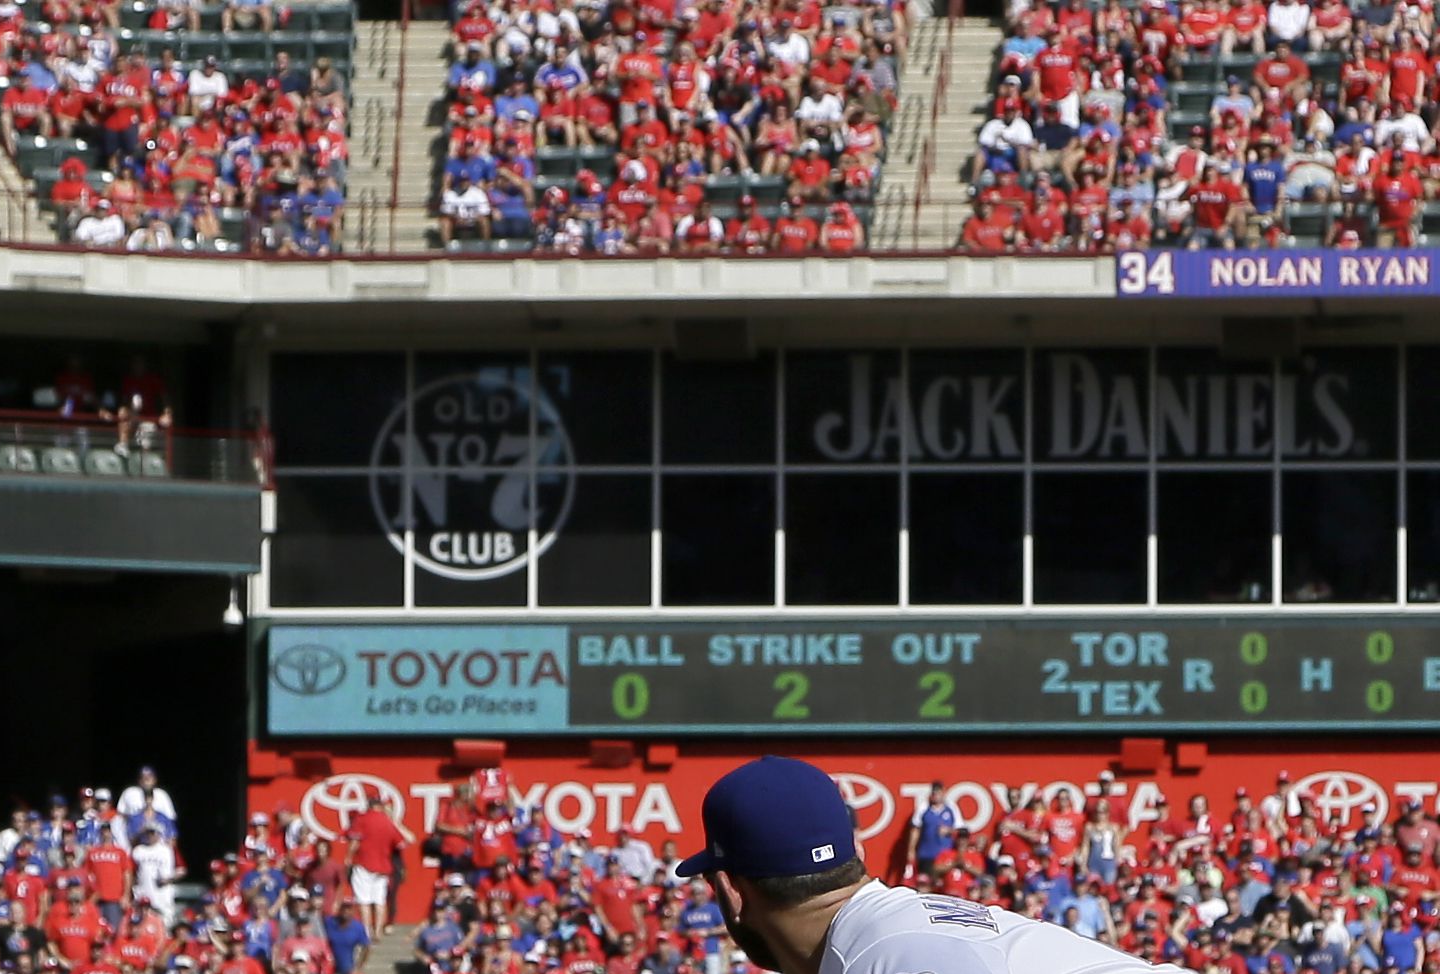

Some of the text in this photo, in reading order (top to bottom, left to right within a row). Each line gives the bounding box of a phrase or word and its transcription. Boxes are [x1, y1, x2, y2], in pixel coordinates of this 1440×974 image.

[1120, 252, 1429, 293] 34 NOLAN RYAN
[434, 391, 511, 424] OLD
[814, 354, 1022, 460] JACK
[428, 532, 516, 564] CLUB
[578, 633, 980, 665] BALL STRIKE OUT
[1072, 633, 1169, 666] TOR
[1183, 659, 1216, 692] R
[1240, 632, 1268, 665] 0
[1301, 659, 1333, 691] H
[1366, 632, 1394, 665] 0
[357, 650, 566, 688] TOYOTA
[612, 672, 955, 719] 0 2 2
[1042, 659, 1163, 716] 2 TEX
[1240, 680, 1268, 714] 0
[1366, 680, 1394, 714] 0
[367, 696, 537, 716] Let's Go Places
[409, 782, 684, 834] TYOTA
